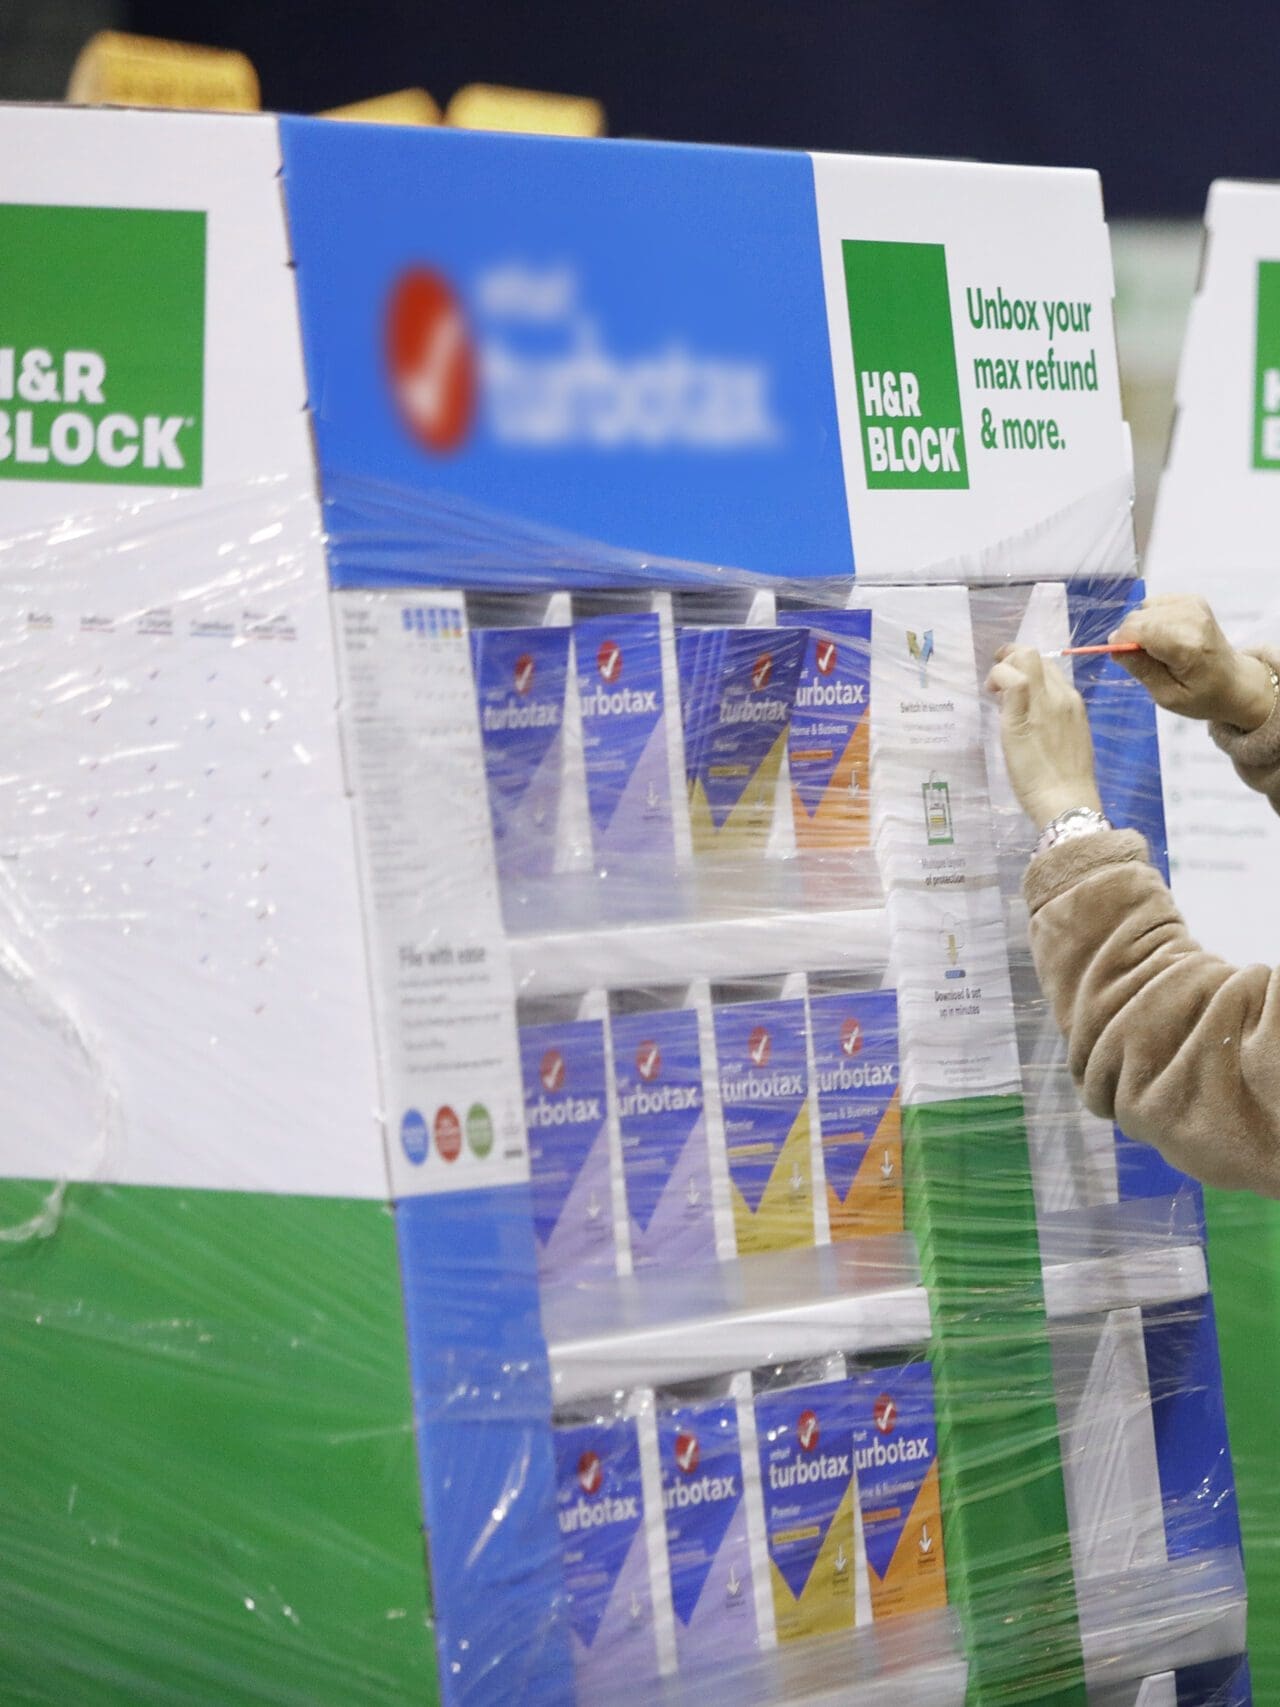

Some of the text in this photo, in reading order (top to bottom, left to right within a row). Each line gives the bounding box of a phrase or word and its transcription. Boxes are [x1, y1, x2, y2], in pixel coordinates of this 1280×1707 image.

[966, 286, 1092, 341] Unbox your
[973, 347, 1099, 392] max refund
[861, 370, 922, 418] H&R
[980, 407, 1066, 450] & more.
[866, 425, 961, 473] BLOCK
[580, 684, 658, 717] urbotax
[795, 677, 866, 708] urbotax
[616, 1083, 699, 1117] urbotax
[720, 1072, 804, 1102] turbotax
[524, 1095, 602, 1127] rbotax
[769, 1453, 850, 1490] turbotax
[854, 1437, 930, 1470] urbotax
[558, 1496, 639, 1533] urbotax
